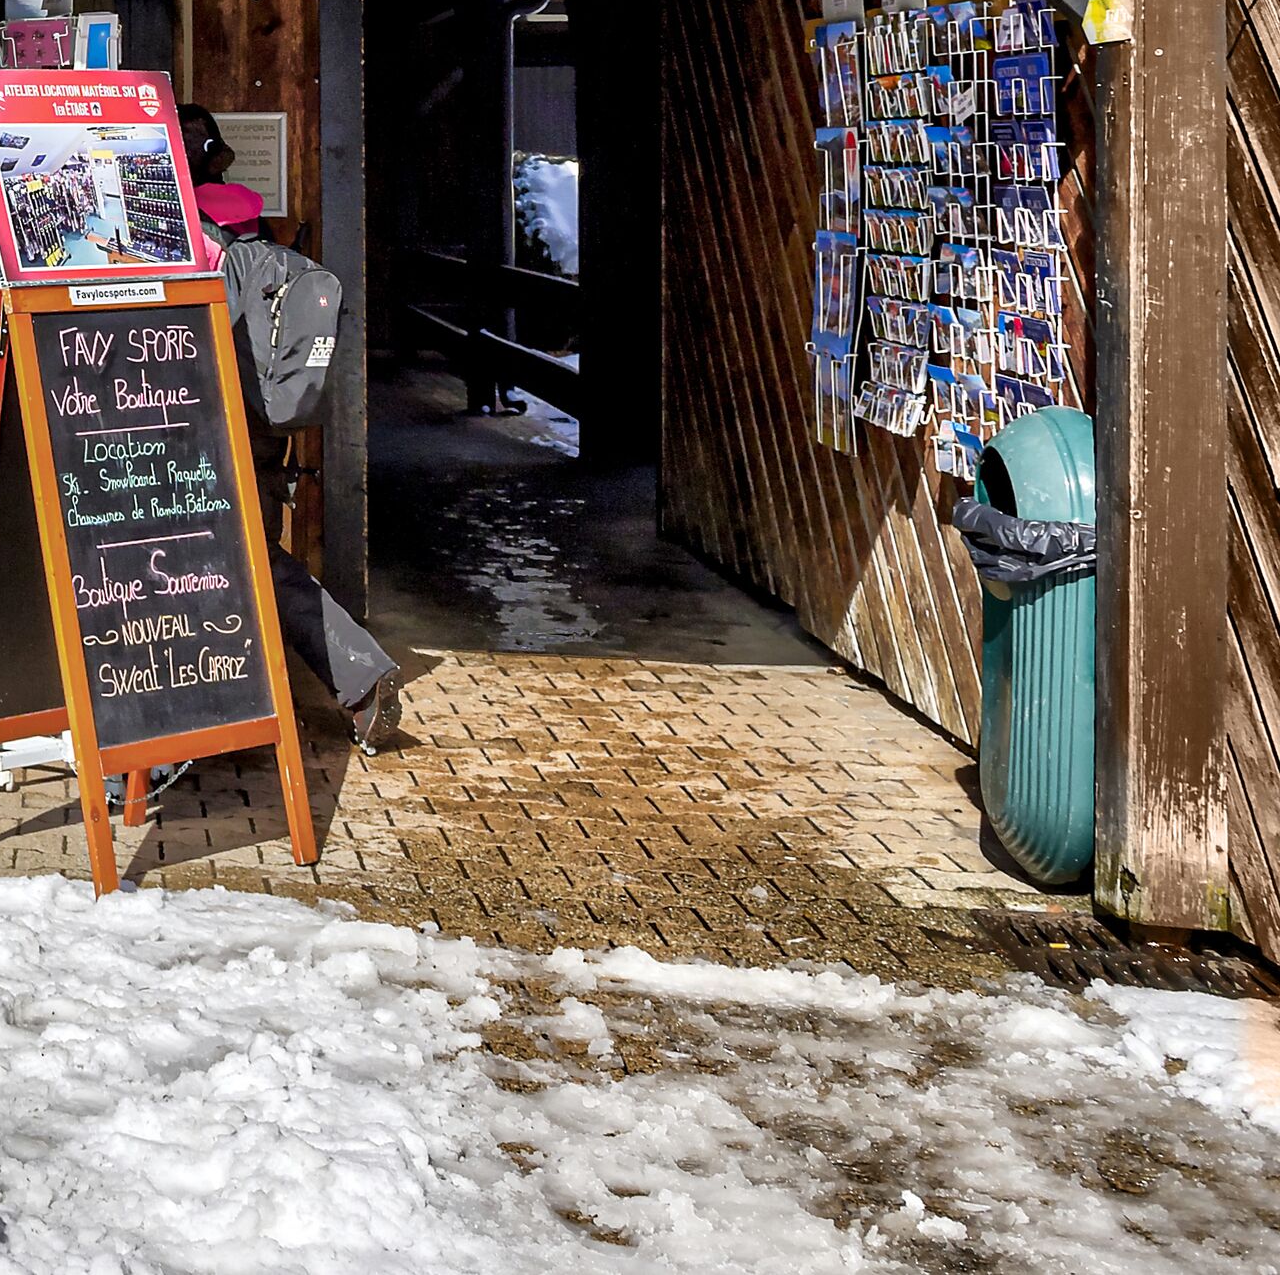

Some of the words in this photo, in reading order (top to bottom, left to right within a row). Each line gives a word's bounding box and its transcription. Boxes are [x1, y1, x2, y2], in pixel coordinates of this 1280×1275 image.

[4, 84, 40, 97] ATELIER
[40, 85, 80, 97] LOCATION
[80, 83, 122, 98] MATÉRIEL
[122, 86, 137, 97] SKI
[76, 287, 157, 301] Favylocsports.com
[59, 327, 114, 366] FAVY
[126, 325, 197, 362] SPORTS
[51, 376, 101, 417] Votre
[114, 368, 200, 425] Boutique
[167, 456, 217, 491] Raquettes
[67, 495, 125, 527] Chaussures
[132, 494, 144, 520] de
[72, 557, 147, 619] Boutique
[150, 550, 229, 594] Souvenirs
[122, 614, 196, 646] NOUVEAU
